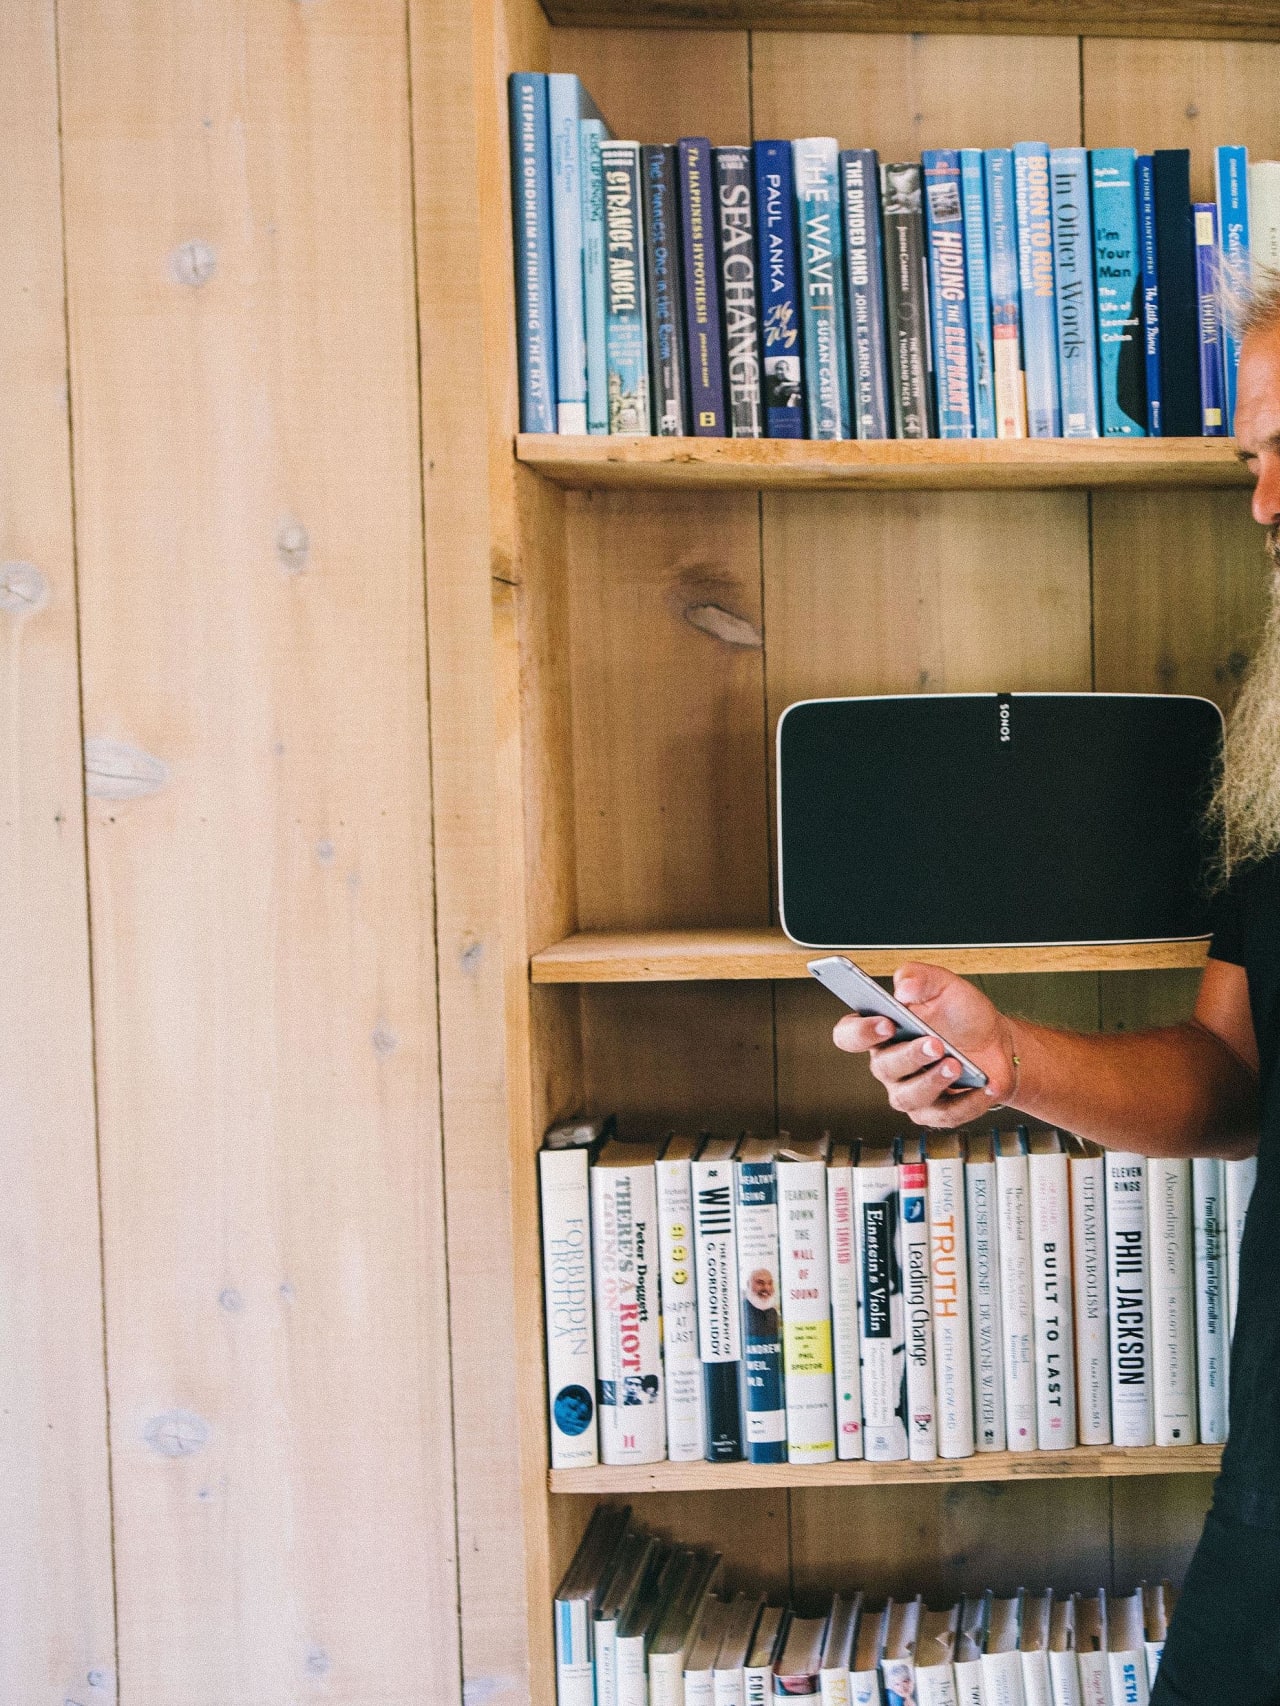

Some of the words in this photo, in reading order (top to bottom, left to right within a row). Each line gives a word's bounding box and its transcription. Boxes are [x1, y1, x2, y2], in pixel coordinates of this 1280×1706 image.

[521, 85, 533, 153] STEPHEN
[650, 153, 665, 179] The
[687, 148, 699, 167] The
[804, 152, 829, 202] THE
[845, 160, 863, 186] THE
[523, 157, 537, 238] SONDHEIM
[689, 171, 704, 240] HAPPINESS
[766, 175, 782, 227] PAUL
[1015, 157, 1029, 225] Christopher
[1027, 156, 1049, 217] BORN
[1055, 173, 1077, 194] In
[605, 171, 632, 251] STRANGE
[650, 184, 667, 242] Funniest
[720, 185, 751, 251] SEA
[847, 190, 866, 245] DIVIDED
[807, 214, 833, 296] WAVE
[1018, 228, 1032, 289] McDougall
[1030, 221, 1051, 250] TO
[1056, 204, 1082, 273] Other
[1097, 229, 1120, 242] I'm
[1098, 247, 1131, 261] Your
[1228, 224, 1243, 267] Search
[654, 247, 668, 275] One
[692, 243, 707, 323] HYPOTHESIS
[769, 234, 784, 292] ANKA
[851, 249, 868, 285] MIND
[931, 230, 965, 301] HIDING
[1033, 255, 1053, 296] RUN
[1099, 265, 1132, 278] Man
[526, 252, 539, 329] FINISHING
[610, 258, 635, 313] ANGEL
[657, 280, 668, 293] in
[657, 296, 670, 319] the
[1145, 285, 1157, 300] The
[725, 254, 759, 406] CHANGE
[946, 305, 961, 323] THE
[1060, 281, 1085, 359] Words
[1146, 302, 1158, 325] Little
[528, 336, 541, 364] THE
[658, 323, 672, 360] Room
[817, 320, 830, 363] SUSAN
[1146, 327, 1158, 355] Prince
[530, 369, 542, 398] HAT
[819, 368, 832, 409] CASEY
[944, 326, 970, 415] ELEPHANT
[1000, 703, 1010, 743] SONOS
[698, 1186, 732, 1237] WILL
[784, 1189, 819, 1201] TEARING
[941, 1166, 953, 1212] LIVING
[975, 1178, 988, 1236] EXCUSES
[1165, 1171, 1178, 1239] Abounding
[615, 1176, 635, 1272] THERE'S
[634, 1222, 646, 1261] Peter
[866, 1209, 884, 1284] Einstein's
[707, 1243, 716, 1254] G.
[719, 1242, 727, 1259] THE
[792, 1249, 815, 1261] WALL
[932, 1215, 958, 1318] TRUTH
[977, 1240, 990, 1296] BEGONE!
[1082, 1176, 1099, 1320] ULTRAMETABOLISM
[1114, 1231, 1143, 1277] PHIL
[1167, 1242, 1179, 1274] Grace
[550, 1238, 572, 1338] EROTICA
[564, 1218, 588, 1357] FORBIDDEN
[617, 1277, 636, 1295] A
[636, 1264, 649, 1323] Doggett
[707, 1257, 718, 1315] GORDON
[790, 1288, 819, 1300] SOUND
[907, 1242, 927, 1305] Leading
[1043, 1242, 1058, 1304] BUILT
[719, 1262, 730, 1340] AUTOBIOGRAPHY
[869, 1288, 886, 1331] Violin
[979, 1304, 990, 1324] DR.
[619, 1303, 640, 1373] RIOT
[710, 1319, 720, 1357] LIDDY
[723, 1342, 731, 1355] OF
[909, 1309, 930, 1366] Change
[979, 1325, 992, 1372] WAYNE
[1045, 1316, 1059, 1342] TO
[1116, 1286, 1145, 1385] JACKSON
[982, 1376, 993, 1389] W.
[1047, 1353, 1061, 1408] LAST
[982, 1393, 995, 1424] DYER
[1123, 1664, 1137, 1703] SETH
